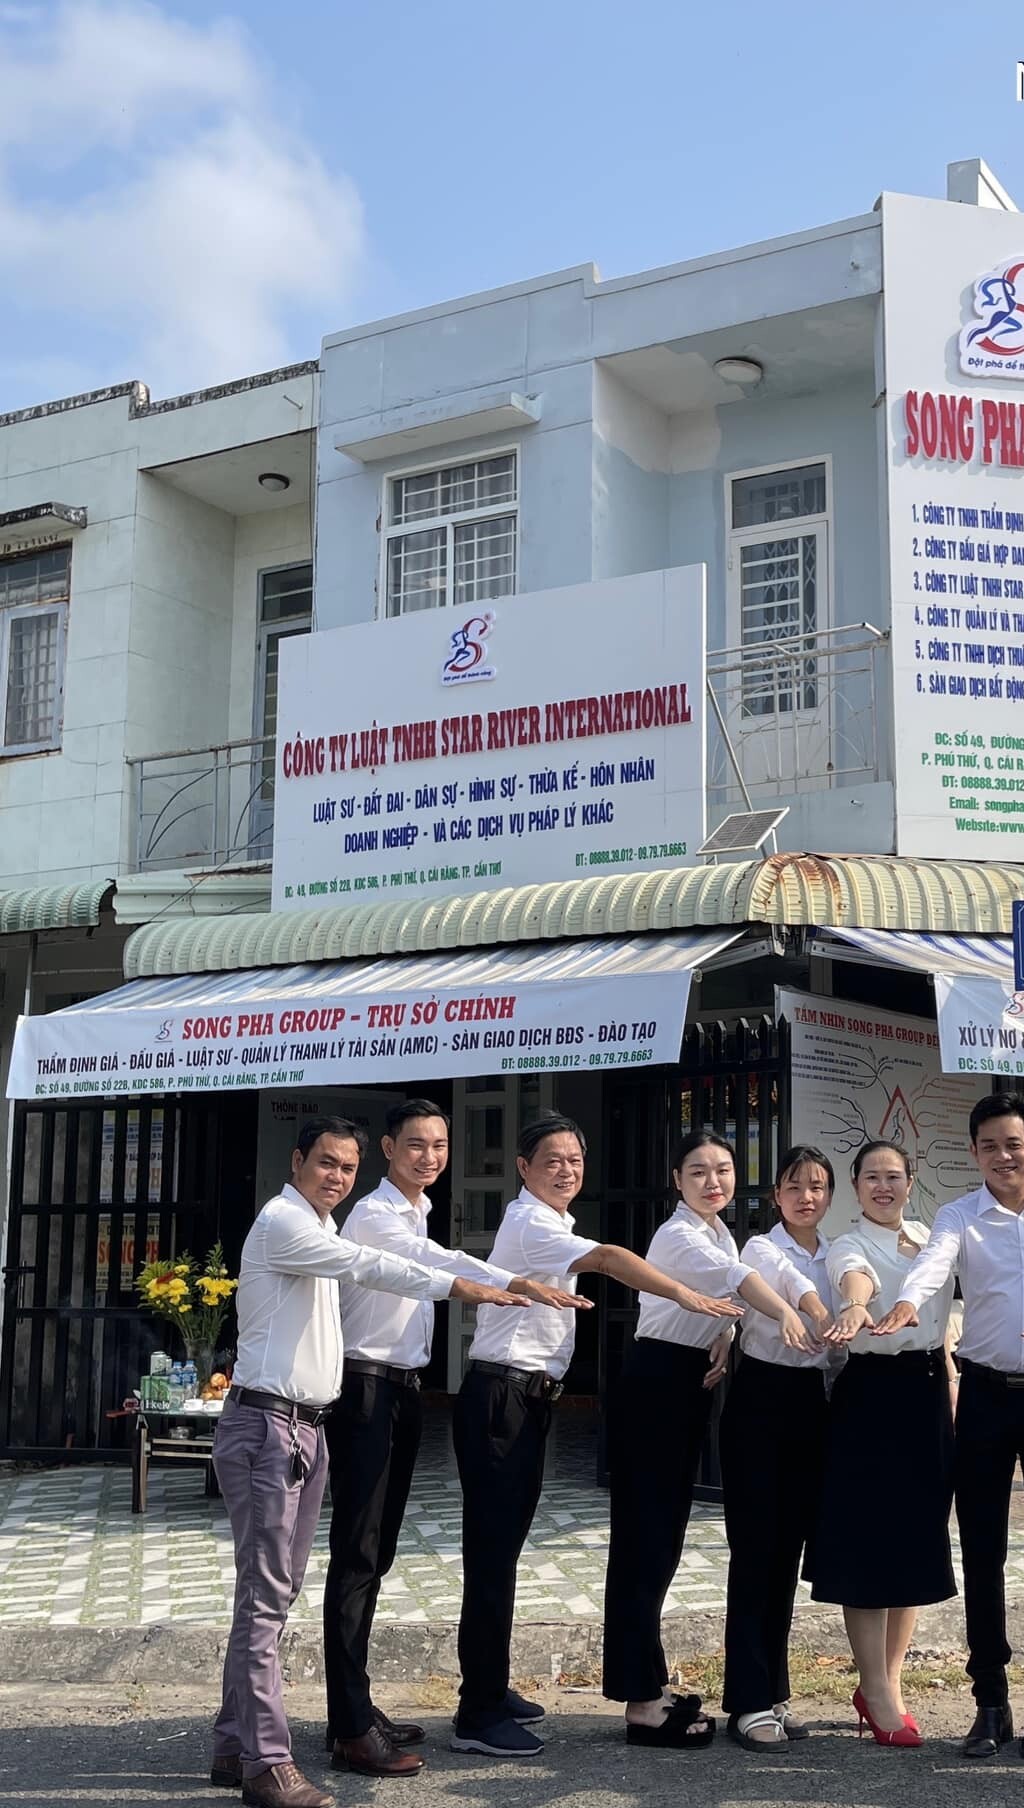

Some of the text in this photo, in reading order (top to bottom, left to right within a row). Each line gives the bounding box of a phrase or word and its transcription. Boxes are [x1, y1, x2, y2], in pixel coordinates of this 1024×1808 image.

[968, 357, 983, 368] Đột
[985, 359, 1002, 369] phá
[1005, 360, 1017, 369] để
[906, 390, 974, 462] SONG
[914, 571, 922, 591] 3.
[926, 570, 946, 592] CÔNG
[948, 574, 957, 594] TY
[960, 573, 978, 598] LUẬT
[982, 577, 1002, 597] TNHH
[1004, 579, 1023, 599] STAR
[915, 640, 924, 659] 5.
[928, 638, 949, 661] CÔNG
[952, 643, 961, 662] TY
[964, 644, 984, 663] TNHH
[987, 645, 1005, 668] DỊCH
[917, 673, 925, 693] 6.
[929, 671, 946, 694] SÀN
[949, 676, 966, 696] GIAO
[969, 677, 986, 700] DỊCH
[989, 673, 1002, 698] BẤT
[283, 684, 691, 778] CÔNG TY LUẬT TNHH STAR RIVER INTERNATIONAL
[935, 733, 952, 746] ĐC:
[955, 730, 968, 746] SỐ
[970, 735, 985, 749] 49,
[314, 757, 654, 824] LUẬT SƯ ĐẤT ĐAI DÂN SỰ HÌNH SỰ THỪA KẾ HÔN NHÂN
[942, 775, 958, 788] ĐT:
[961, 776, 1024, 792] 08888.39.012
[949, 797, 979, 810] Email:
[345, 799, 613, 853] DOANH NGHIỆP VÀ CÁC DỊCH VỤ PHÁP LÝ KHÁC
[182, 993, 516, 1040] SONG PHA GROUP TRỤ SỞ CHÍNH
[848, 1018, 924, 1043] SONG PHA GROUP
[38, 1052, 66, 1075] THẨM
[70, 1056, 97, 1076] ĐỊNH
[130, 1048, 152, 1069] ĐẤU
[187, 1047, 214, 1070] LUẬT
[216, 1048, 235, 1065] SƯ
[241, 1042, 271, 1066] QUẢN
[273, 1042, 287, 1062] LÝ
[290, 1043, 327, 1060] THANH
[330, 1038, 345, 1058] LÝ
[349, 1037, 367, 1057] TÀI
[370, 1033, 396, 1056] SẢN
[400, 1036, 438, 1056] (AMC)
[452, 1029, 479, 1051] SÀN
[484, 1030, 514, 1048] GIAO
[519, 1028, 552, 1050] DỊCH
[556, 1026, 584, 1044] BĐS
[598, 1021, 627, 1042] ĐÀO
[632, 1022, 656, 1043] TẠO
[959, 1021, 977, 1046] XỬ
[980, 1024, 995, 1048] LÝ
[999, 1027, 1017, 1053] NỢ
[502, 1049, 653, 1069] ĐT: 08888.39.012 09.79.79.6663
